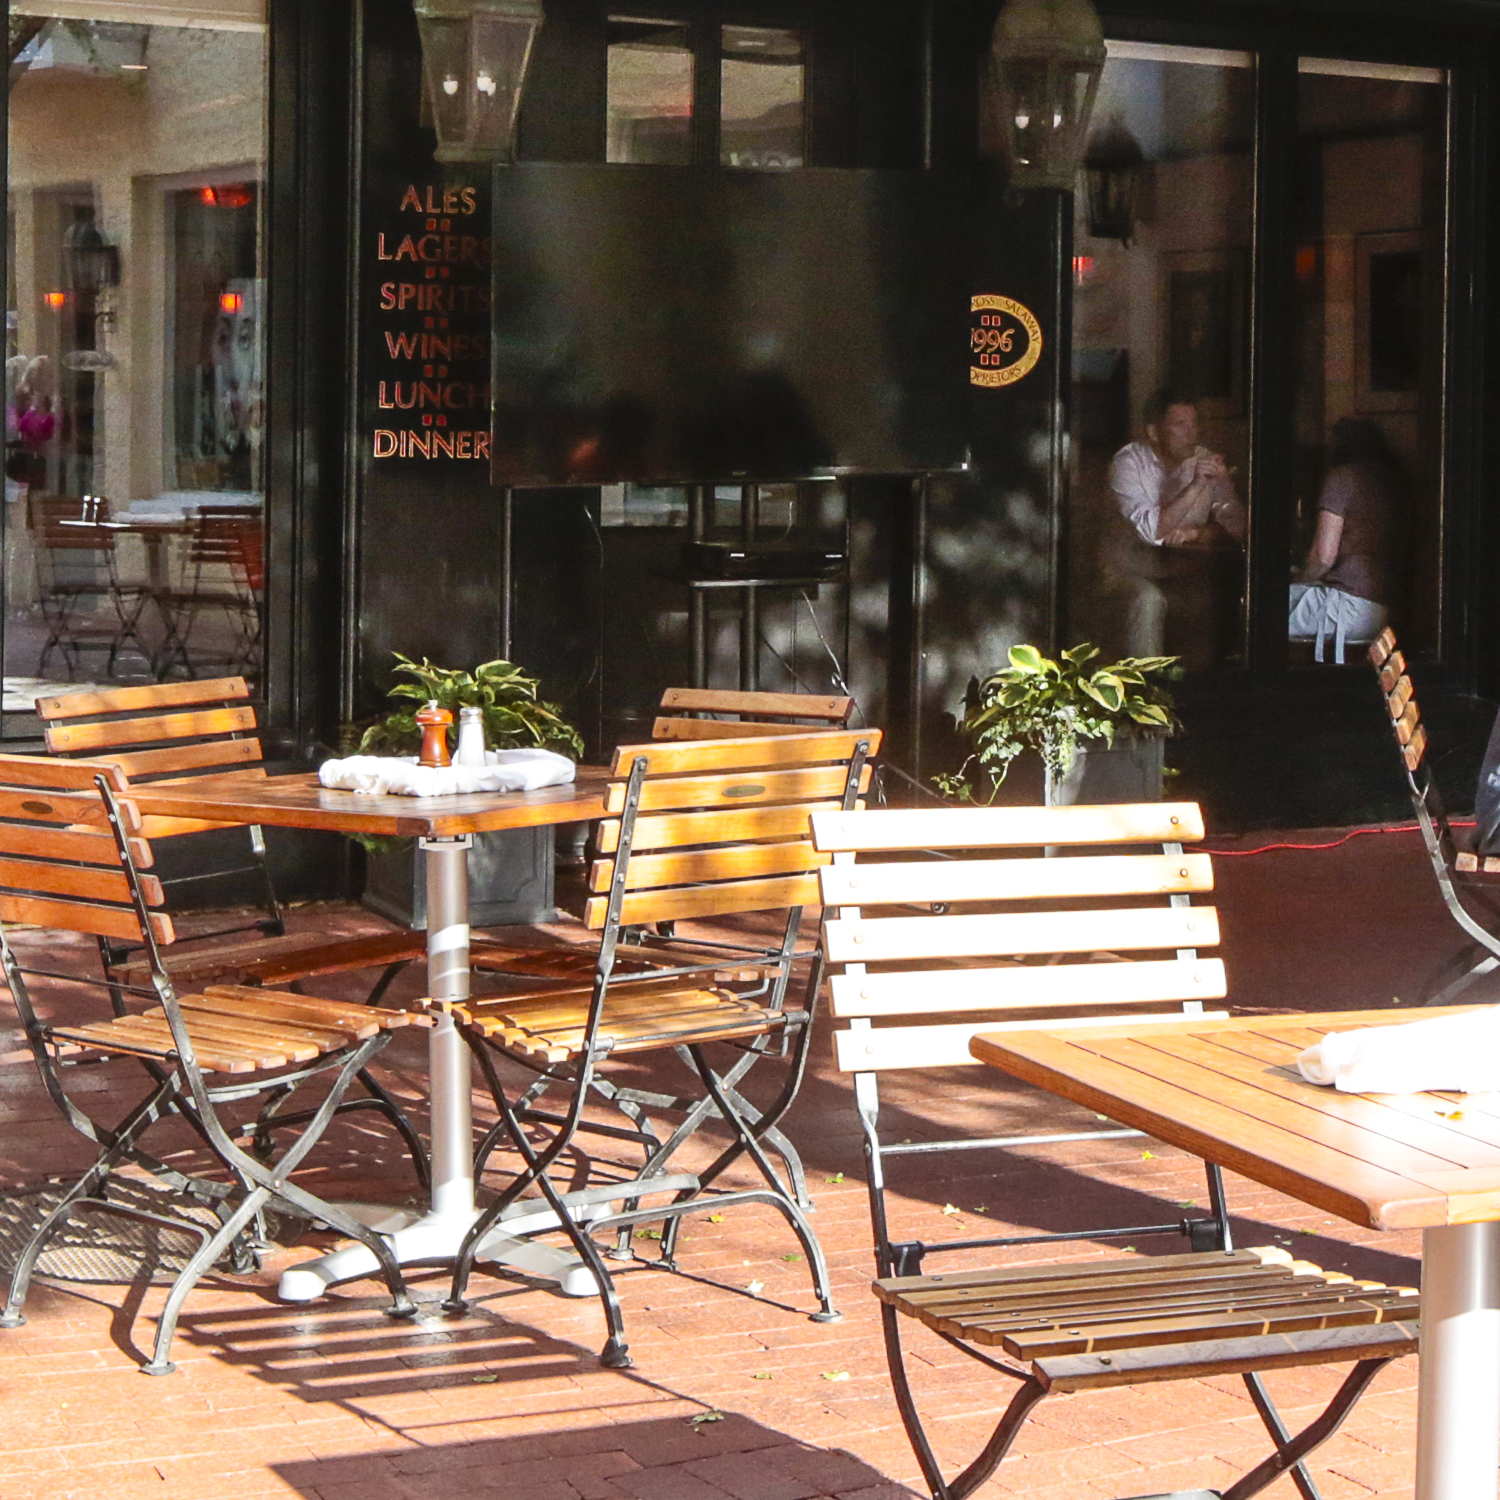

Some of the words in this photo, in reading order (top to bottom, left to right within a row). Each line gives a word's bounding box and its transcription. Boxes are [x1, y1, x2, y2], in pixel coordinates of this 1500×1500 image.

[399, 184, 477, 215] ALES
[1005, 300, 1041, 345] SALAWAY
[384, 331, 488, 362] WINES
[970, 327, 1016, 354] 1996
[379, 380, 491, 410] LUNCH
[373, 429, 491, 460] DINNER
